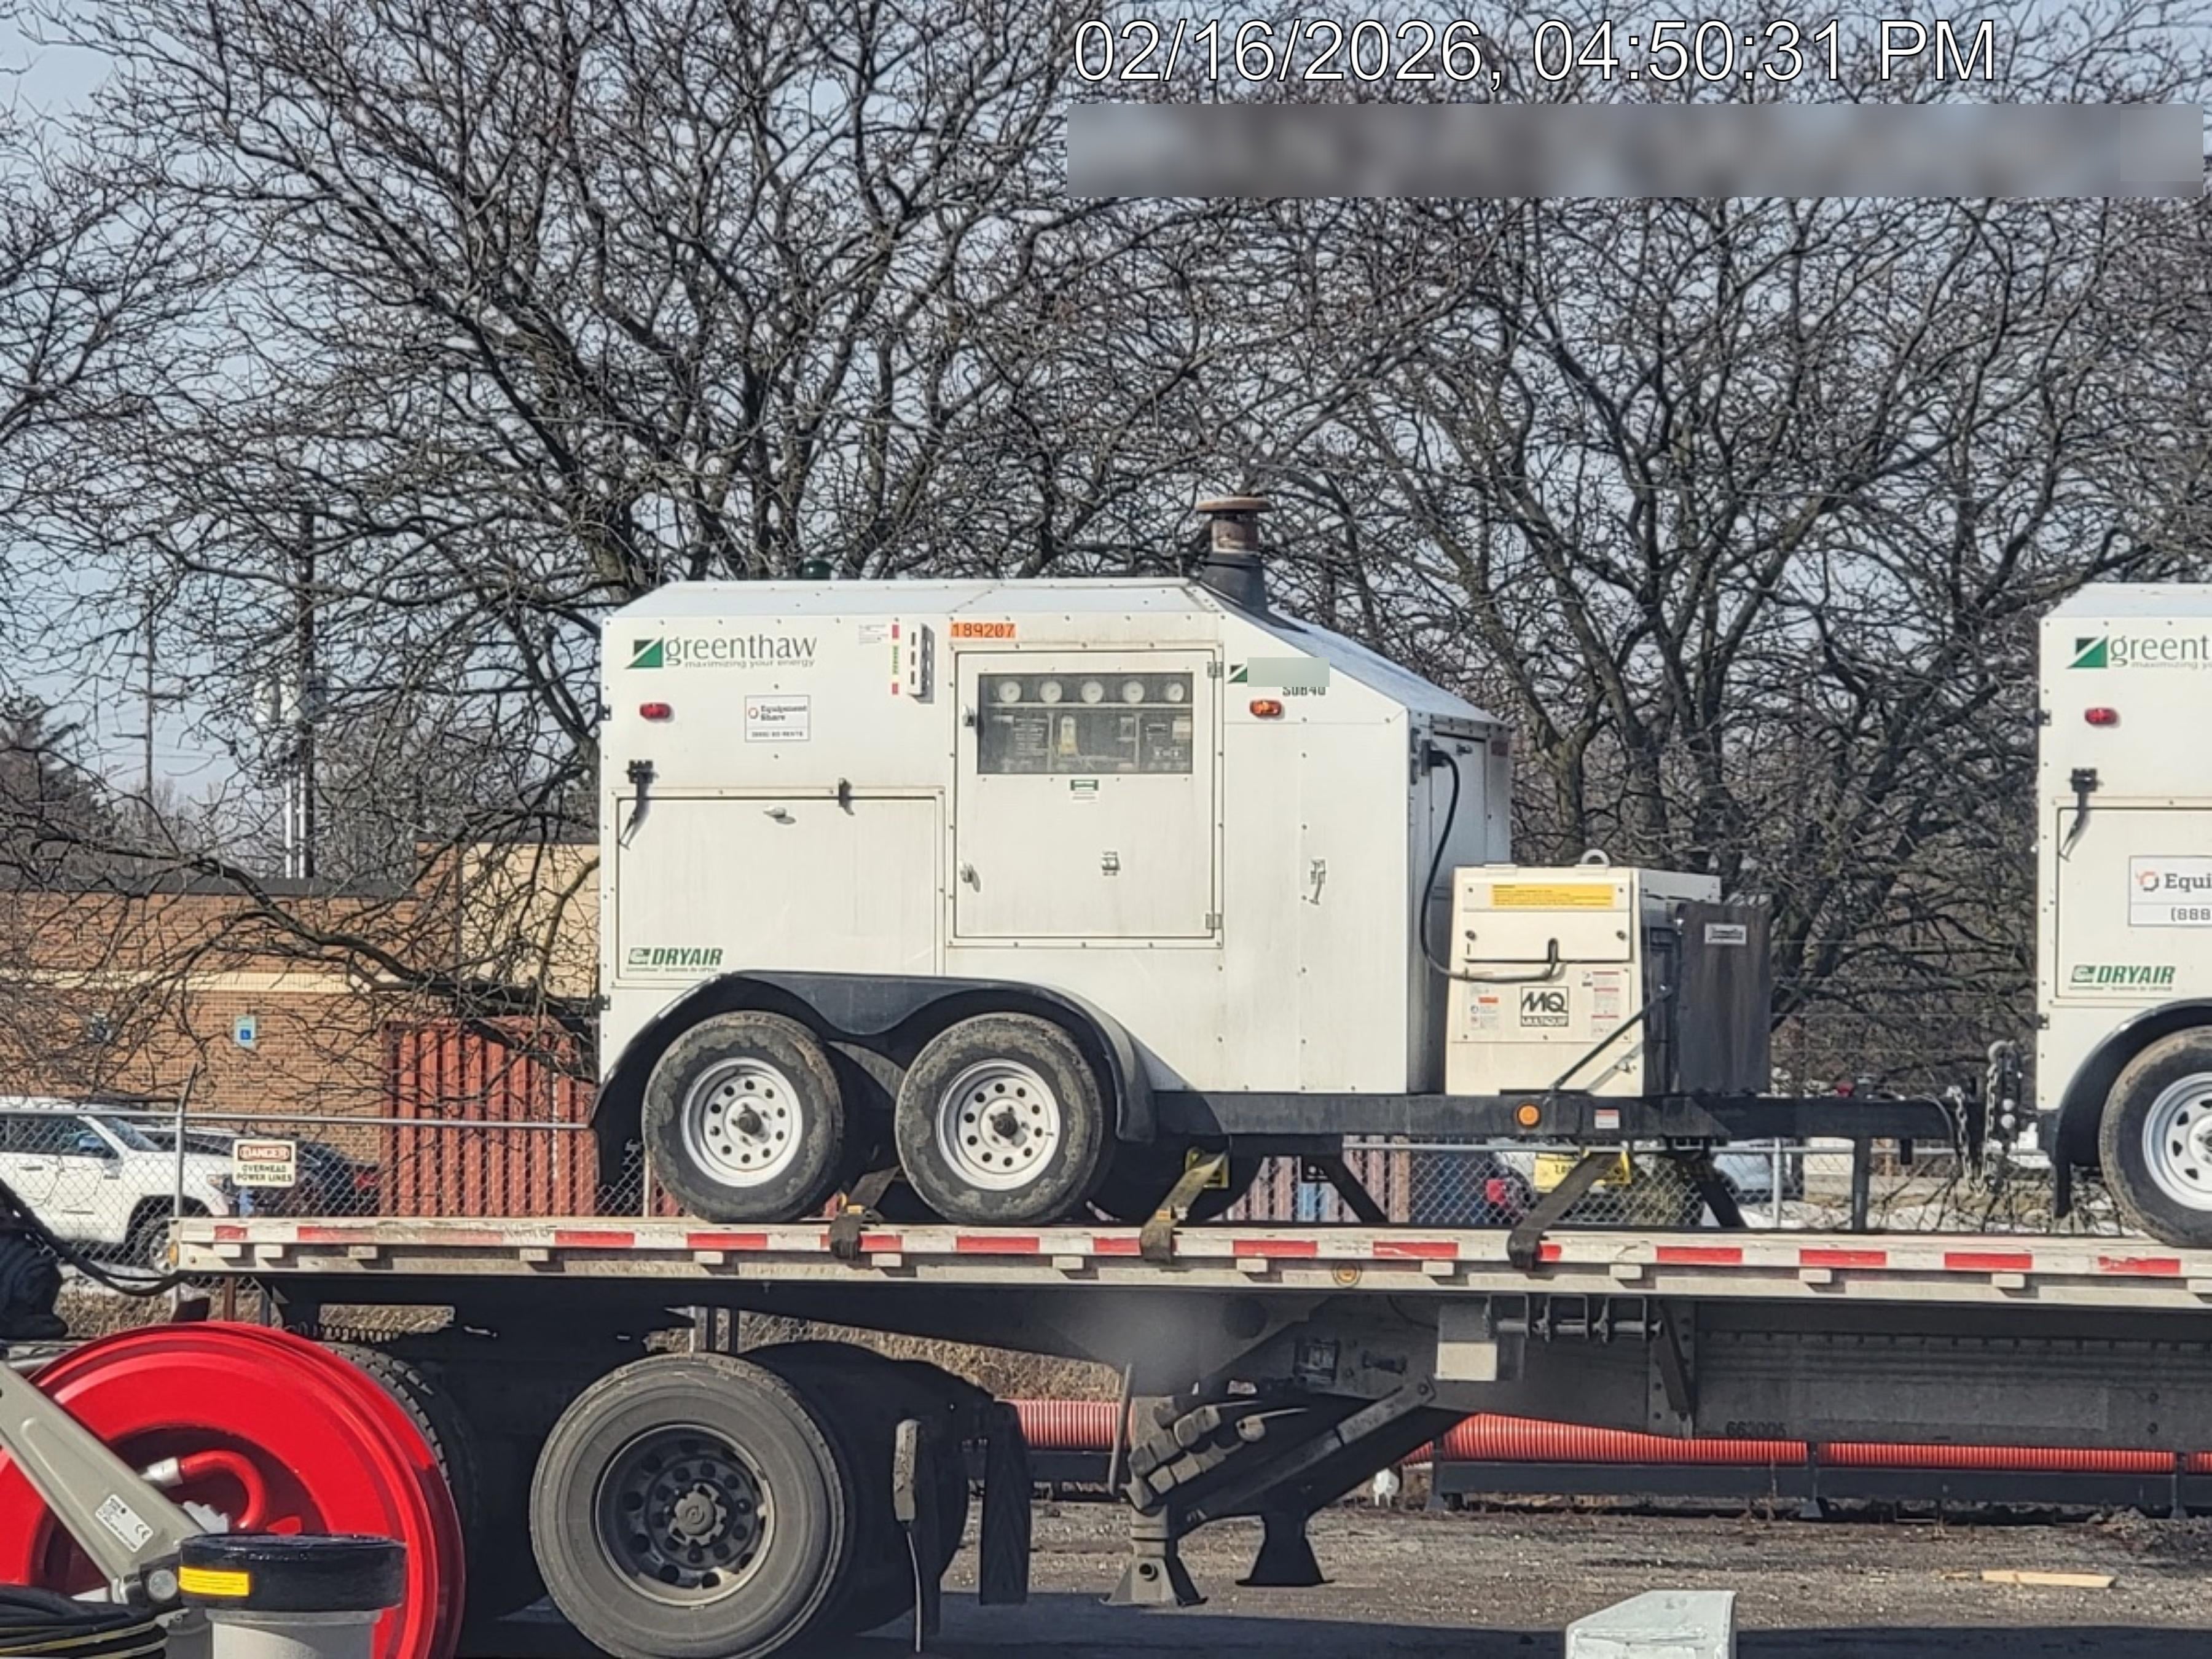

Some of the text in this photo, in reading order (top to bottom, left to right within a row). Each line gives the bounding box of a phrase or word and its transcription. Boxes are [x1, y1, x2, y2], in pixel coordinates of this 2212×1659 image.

[951, 622, 1015, 638] 189207
[665, 633, 818, 666] greenthaw
[651, 947, 724, 965] DRYAIR
[2096, 965, 2176, 983] DRYAIR
[1522, 991, 1569, 1014] MQ
[236, 1172, 292, 1182] POWER LINES
